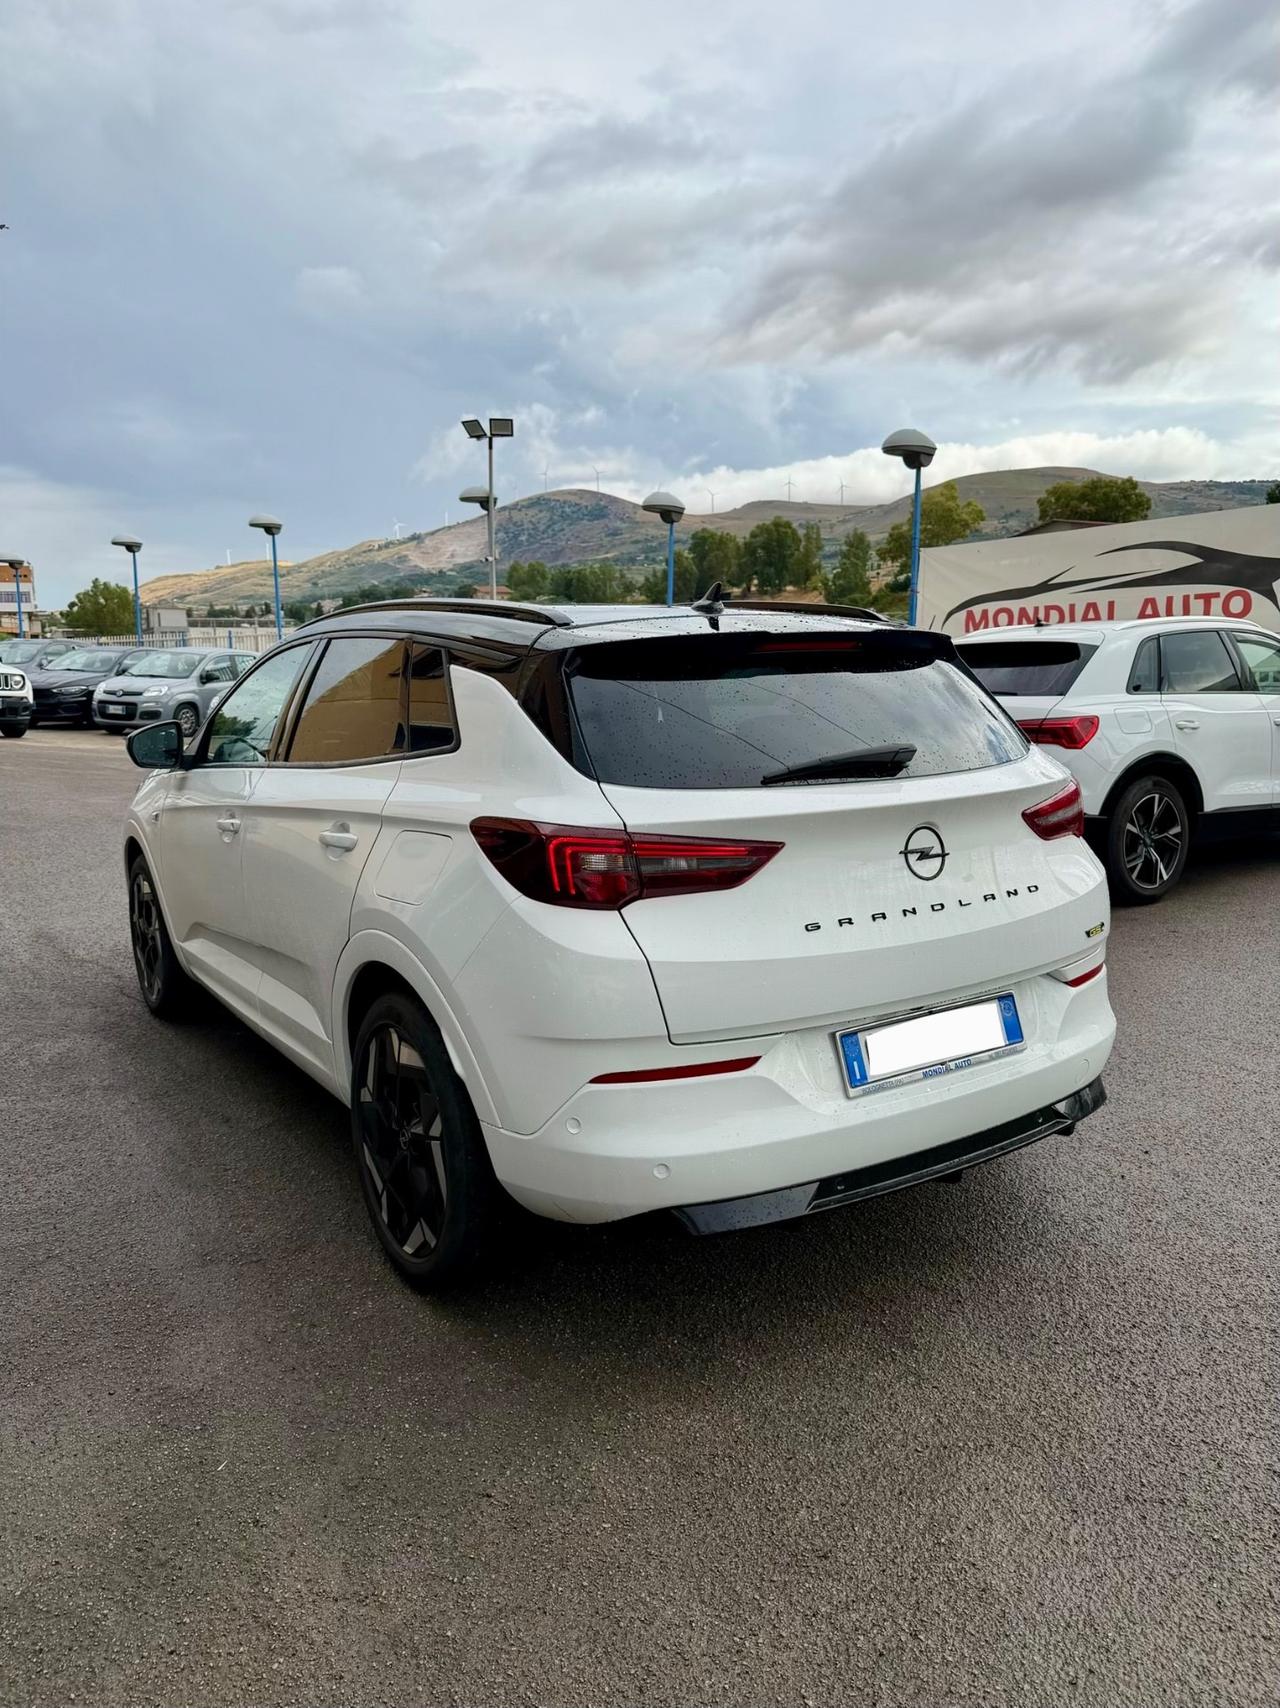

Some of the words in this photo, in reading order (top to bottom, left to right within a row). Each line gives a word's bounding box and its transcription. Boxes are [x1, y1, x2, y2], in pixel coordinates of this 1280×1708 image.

[1136, 589, 1253, 620] AUTO
[804, 885, 1039, 932] GRANDLAND
[922, 1063, 954, 1078] MONDIAL
[954, 1059, 972, 1070] AUTO
